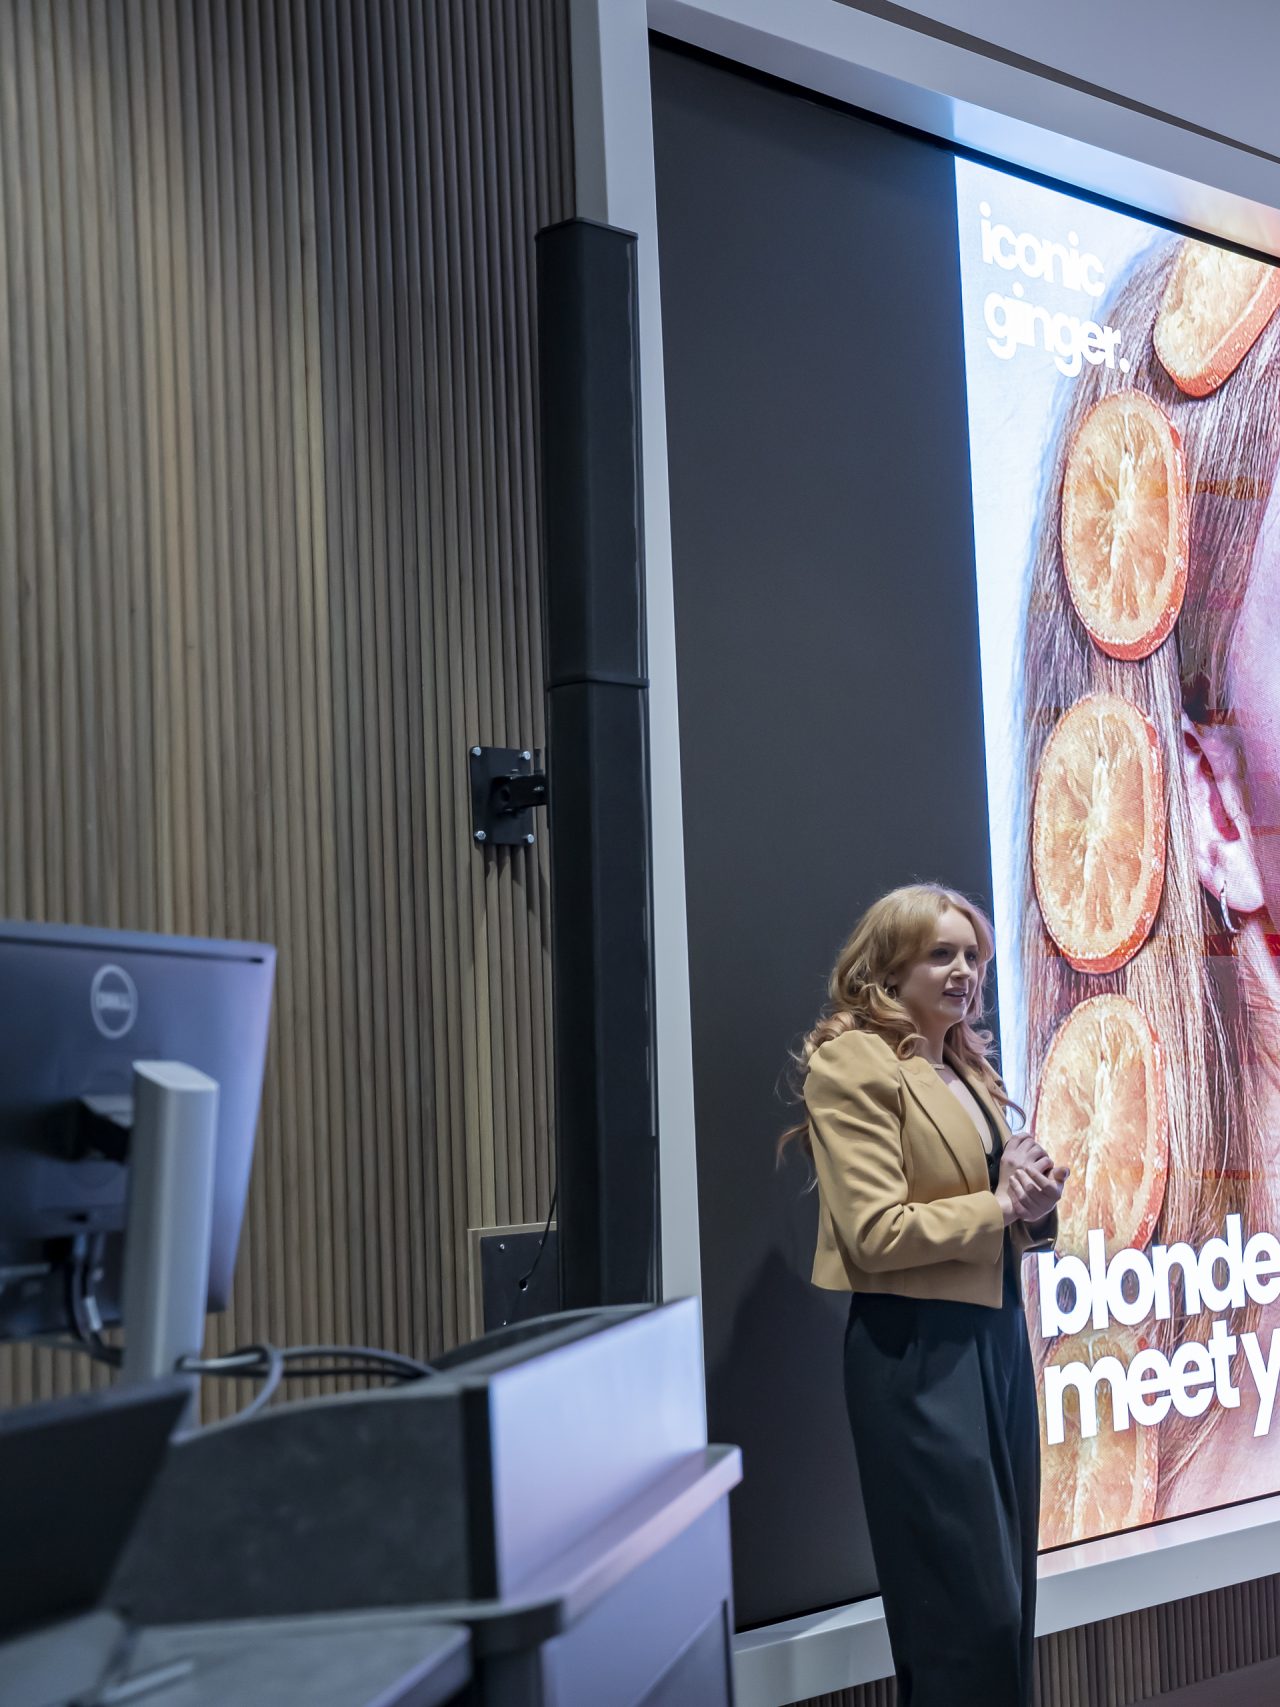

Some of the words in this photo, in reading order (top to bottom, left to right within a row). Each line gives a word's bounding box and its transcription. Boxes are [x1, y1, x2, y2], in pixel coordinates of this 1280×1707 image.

[979, 201, 1105, 297] iconic
[984, 281, 1130, 378] ginger.
[1044, 1321, 1241, 1445] meet
